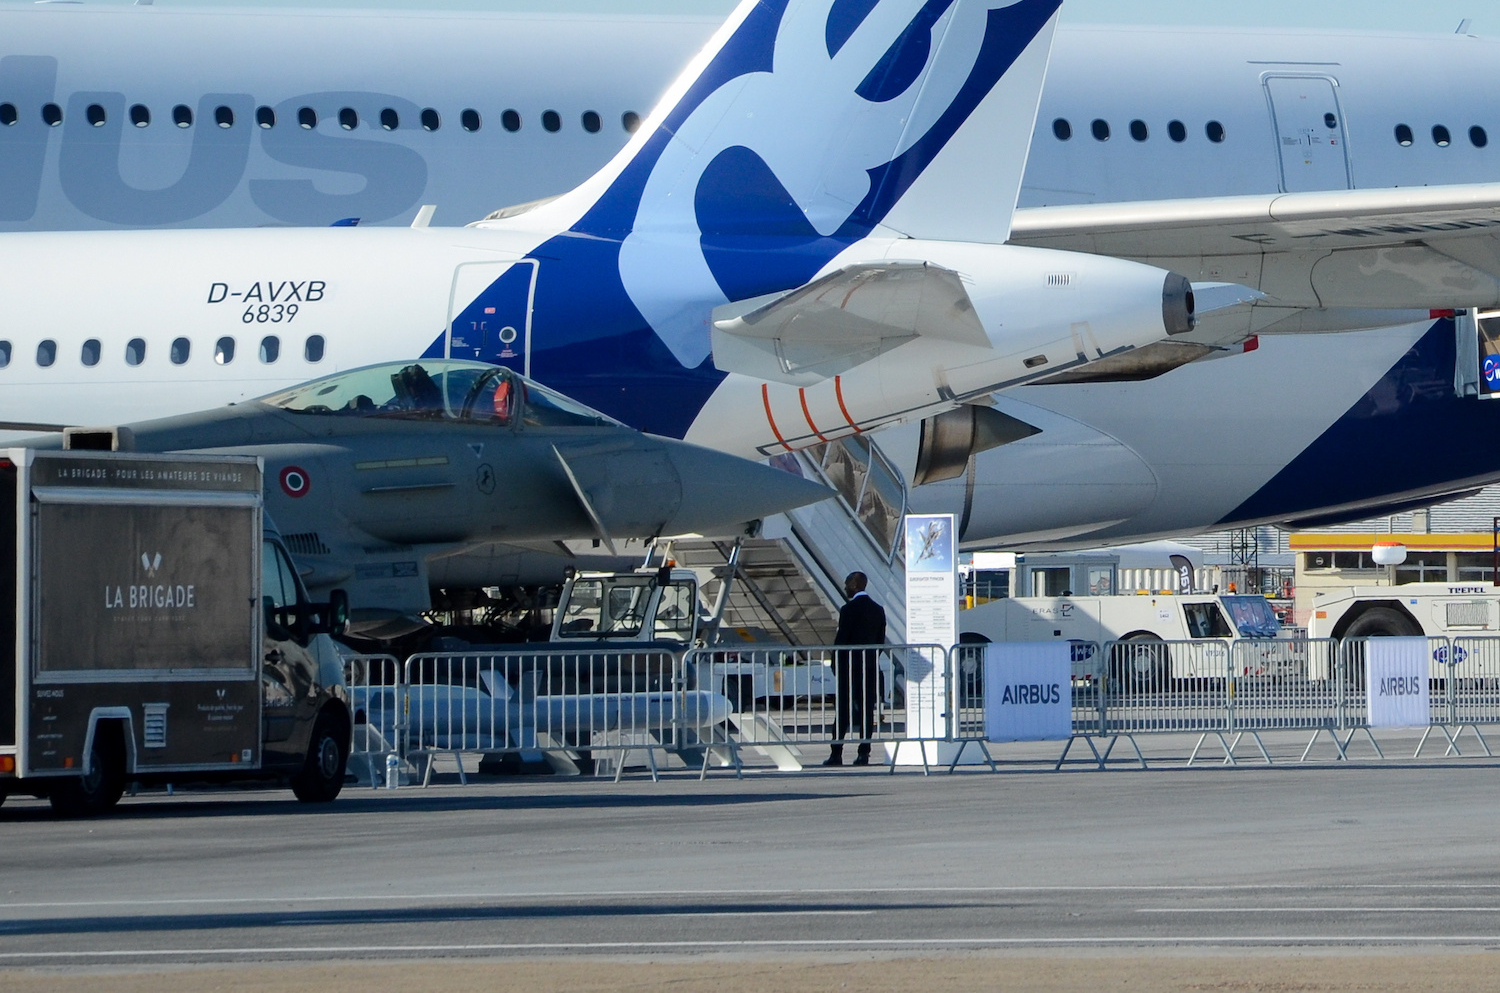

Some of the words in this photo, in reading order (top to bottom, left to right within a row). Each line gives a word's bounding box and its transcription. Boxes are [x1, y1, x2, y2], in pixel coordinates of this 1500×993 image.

[207, 281, 327, 304] D-AVXB
[241, 304, 299, 324] 6839
[58, 468, 67, 478] LA
[72, 468, 107, 479] BRIGADE
[116, 469, 137, 479] POUR
[140, 470, 154, 480] LES
[157, 471, 197, 481] AMATEURS
[200, 472, 211, 481] DE
[214, 472, 242, 483] VIANDE
[105, 585, 123, 609] LA
[129, 584, 195, 608] BRIGADE
[1032, 607, 1059, 615] ERAS
[1001, 684, 1060, 705] AIRBUS
[1379, 675, 1420, 697] AIRBUS
